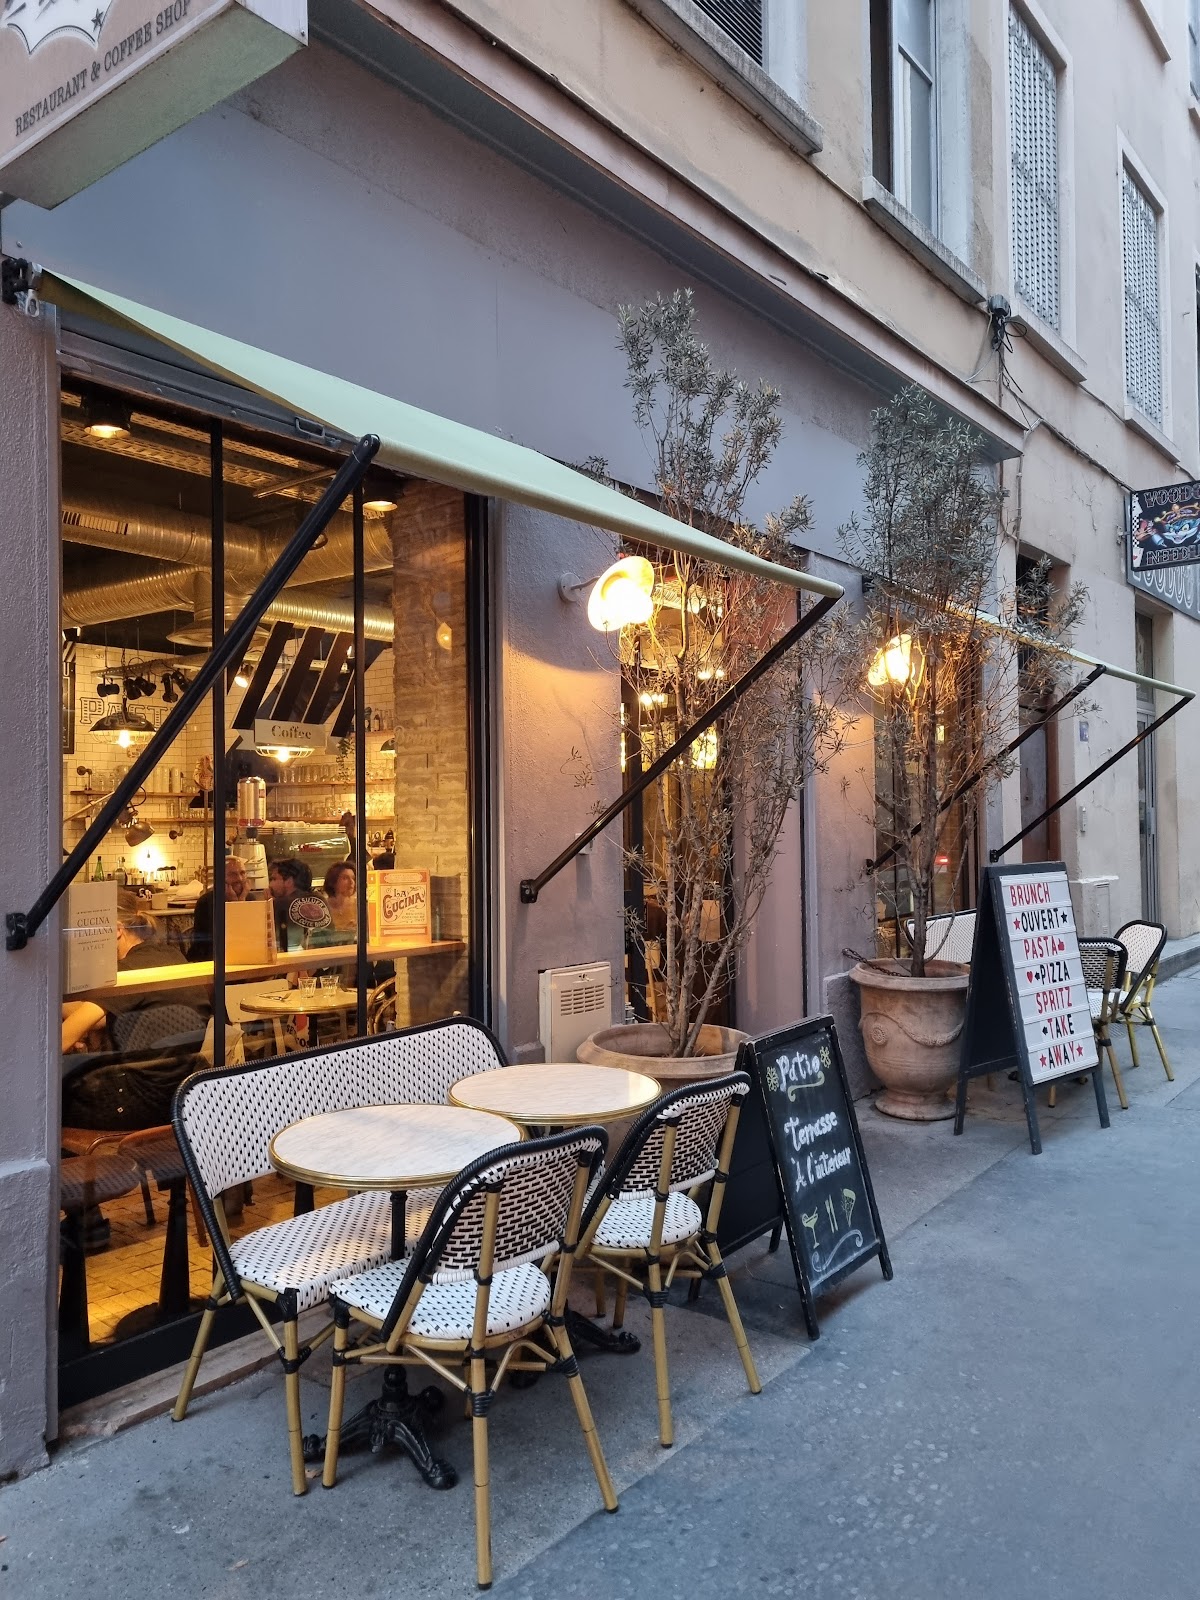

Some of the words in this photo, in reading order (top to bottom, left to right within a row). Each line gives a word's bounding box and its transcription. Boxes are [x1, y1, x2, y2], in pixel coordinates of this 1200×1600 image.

[15, 68, 87, 136] RESTAURANT
[91, 61, 100, 81] &
[104, 21, 152, 71] COFFEE
[156, 0, 190, 35] SHOP
[271, 724, 312, 740] Coffee
[382, 892, 425, 919] CUCINA
[394, 888, 406, 898] LA
[1009, 882, 1051, 907] BRUNCH
[73, 927, 113, 939] ITALIANA
[77, 916, 110, 928] CUCINA
[1021, 908, 1060, 933] OUVERT
[1023, 935, 1058, 960] PASTA
[1039, 961, 1071, 985] PIZZA
[1036, 986, 1073, 1014] SPRITZ
[1047, 1014, 1075, 1040] TAKE
[1048, 1041, 1077, 1069] AWAY
[776, 1051, 820, 1092] Patio
[784, 1111, 838, 1152] Terrasse
